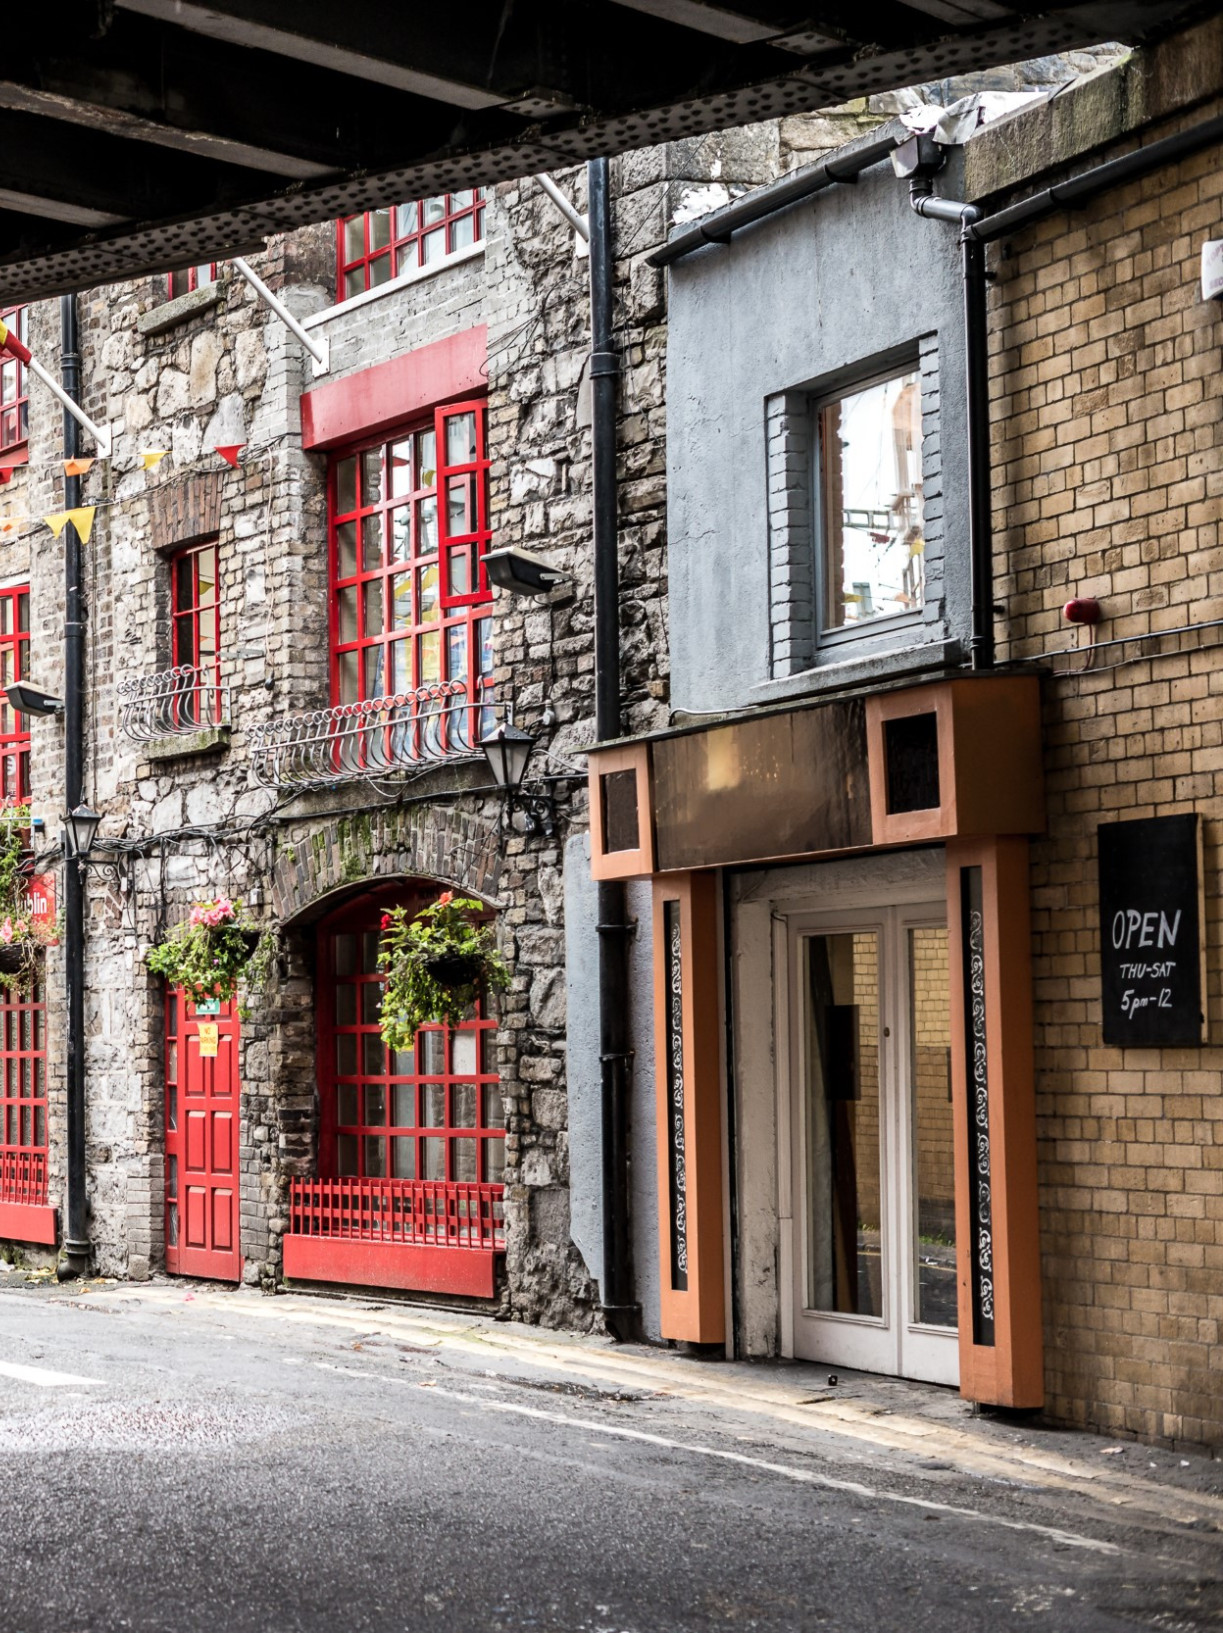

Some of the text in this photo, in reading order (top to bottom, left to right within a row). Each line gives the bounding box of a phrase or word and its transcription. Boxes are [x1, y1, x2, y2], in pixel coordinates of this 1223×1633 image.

[1112, 909, 1182, 950] OPEN
[1119, 961, 1176, 979] THU-SAT
[1120, 988, 1173, 1020] 5pm-12
